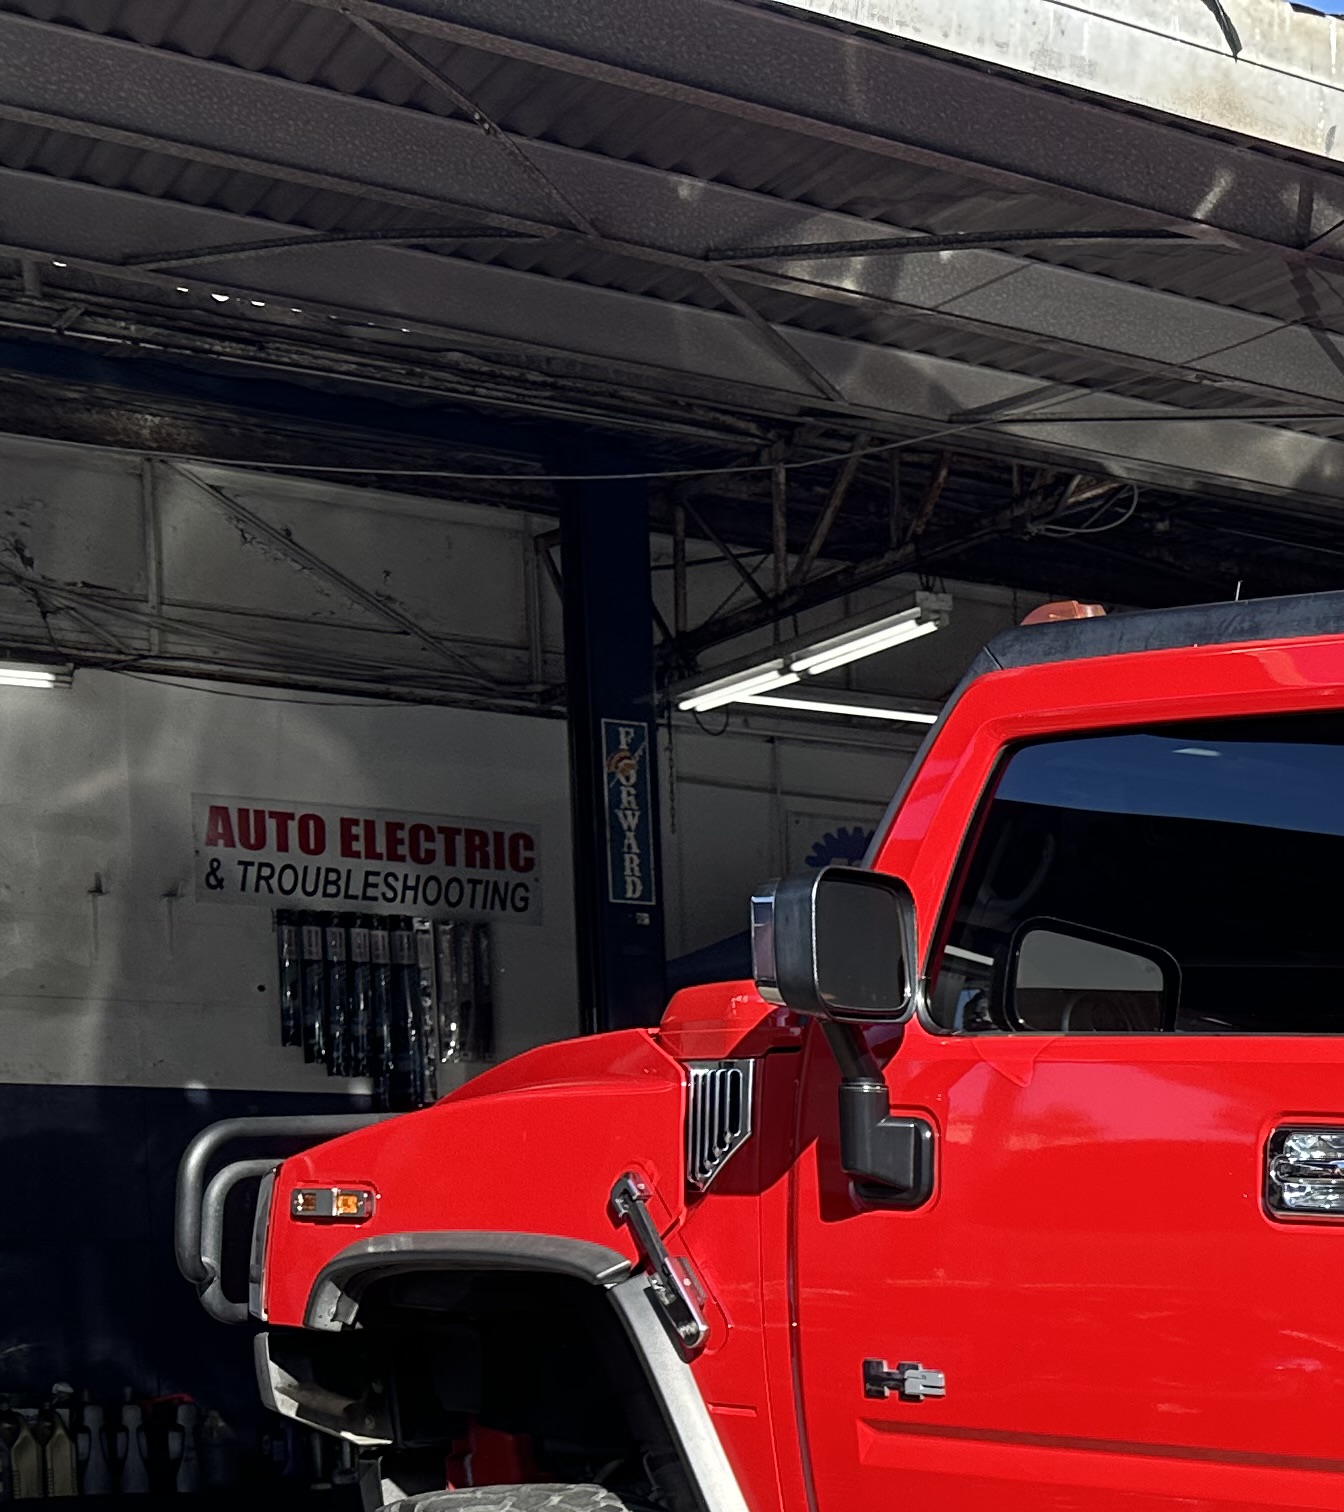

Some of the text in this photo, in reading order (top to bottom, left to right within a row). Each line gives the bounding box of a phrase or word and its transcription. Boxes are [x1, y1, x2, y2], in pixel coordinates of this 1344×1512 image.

[203, 804, 537, 875] AUTO ELECTRIC
[613, 725, 644, 900] FORWARD
[204, 859, 531, 914] & TROUBLESHOOTING
